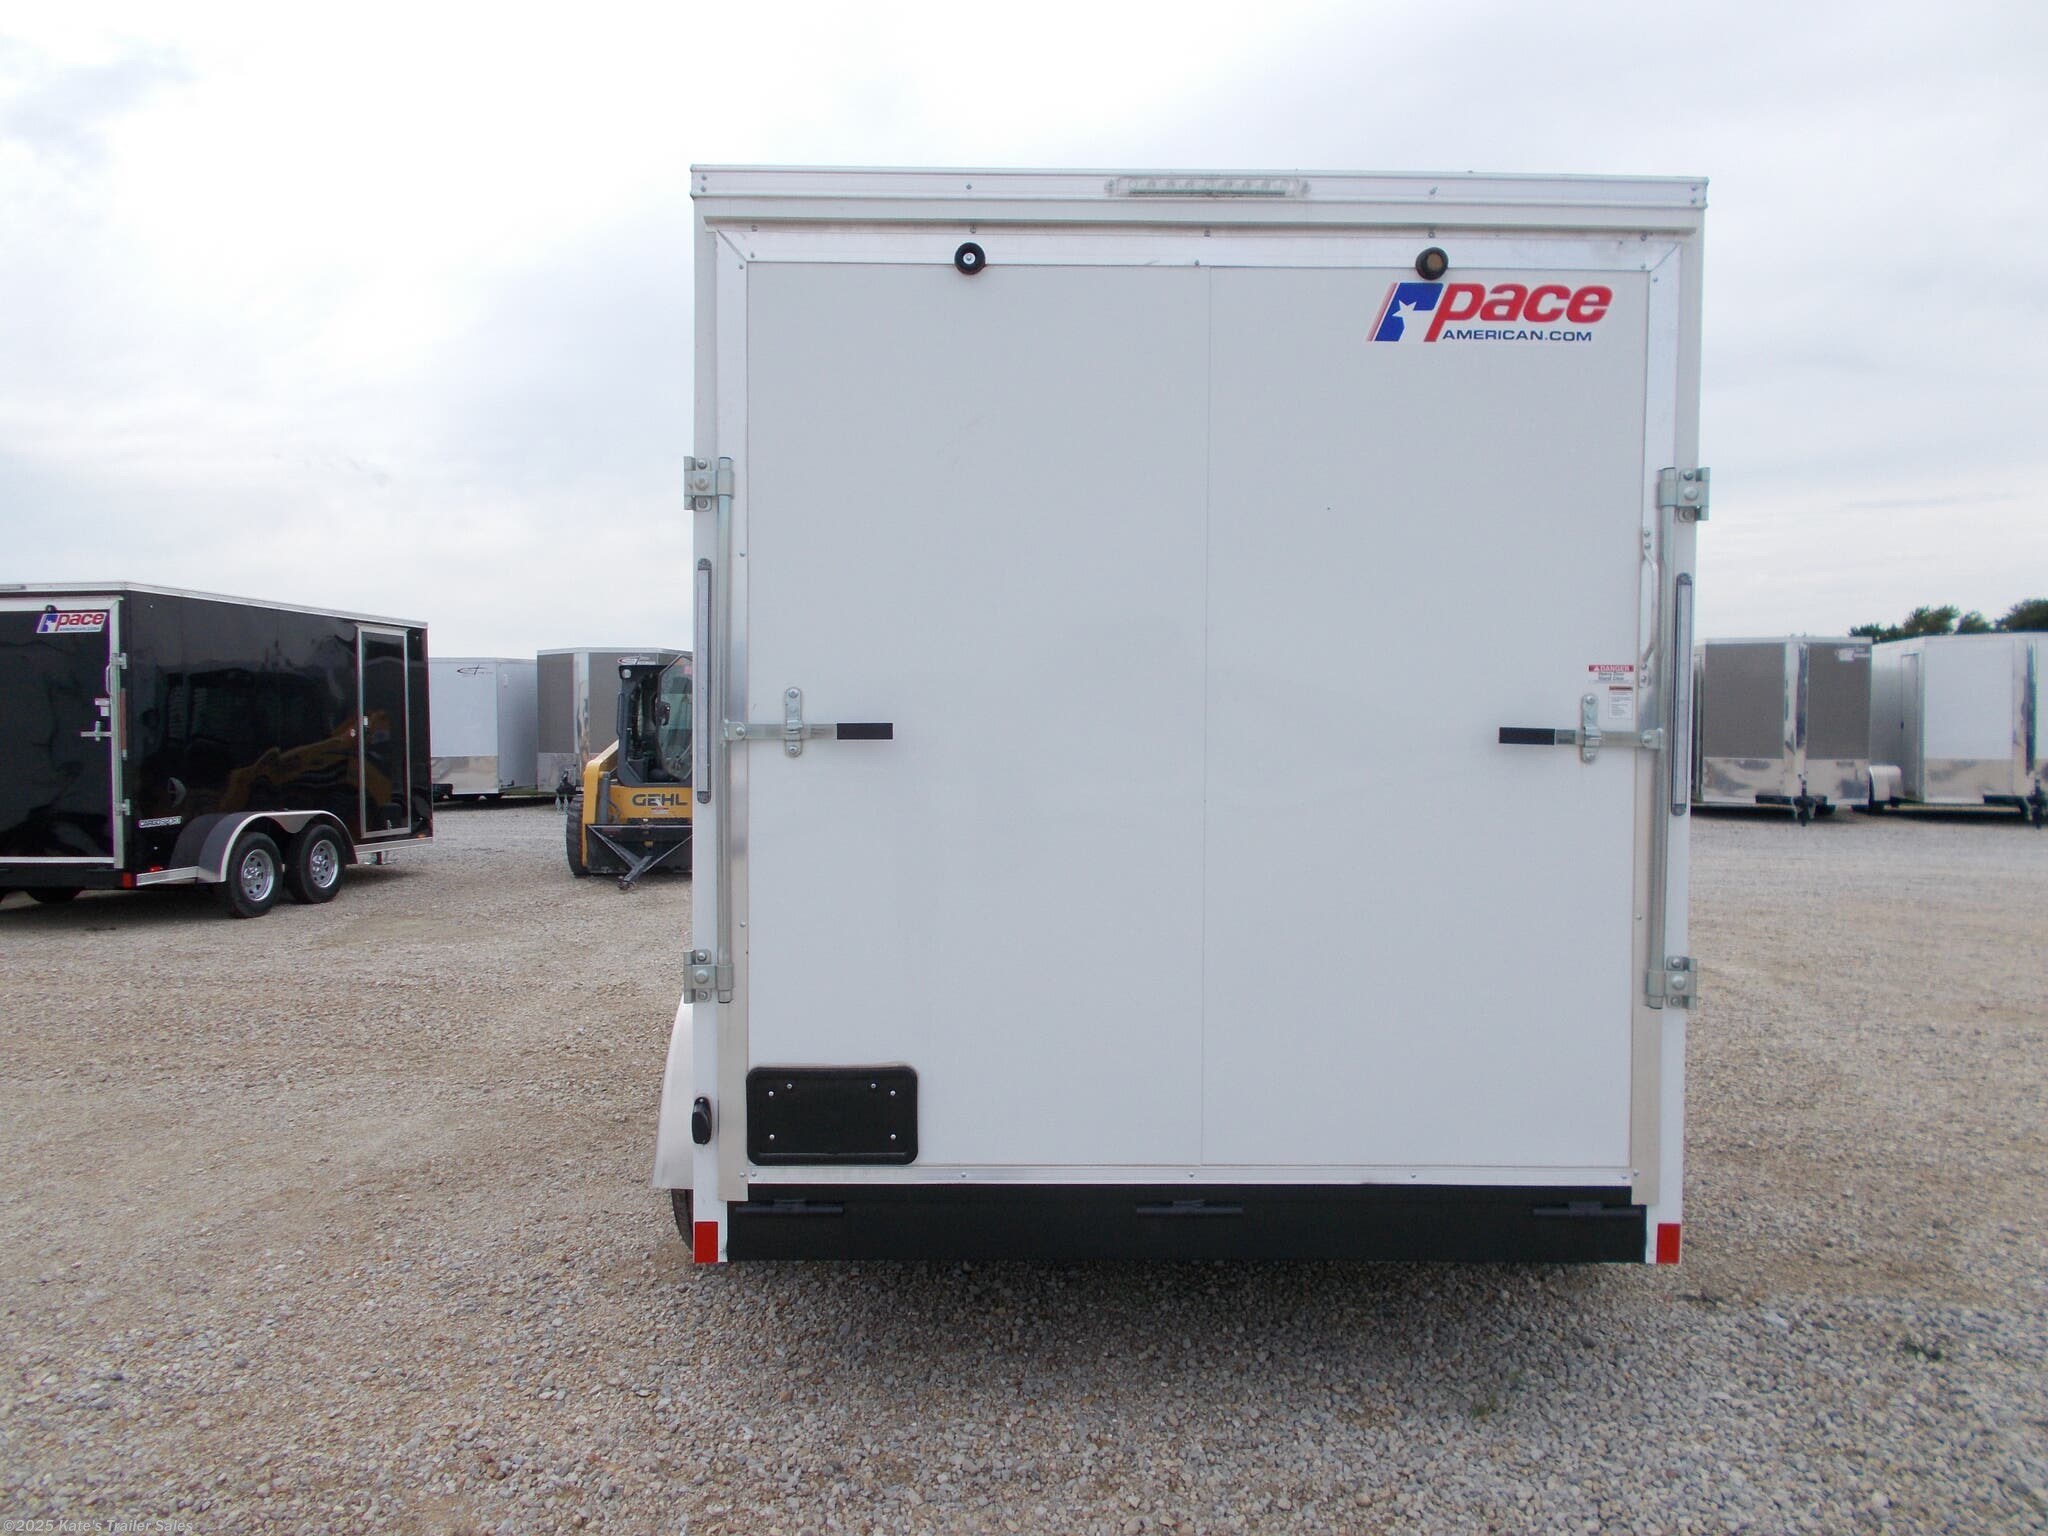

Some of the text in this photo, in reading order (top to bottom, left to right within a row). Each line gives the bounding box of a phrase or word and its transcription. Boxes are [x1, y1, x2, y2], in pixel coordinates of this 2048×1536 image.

[1424, 282, 1613, 342] pace
[1442, 329, 1592, 342] AMERICAN.COM
[55, 613, 105, 631] pace
[632, 793, 688, 806] GEHL
